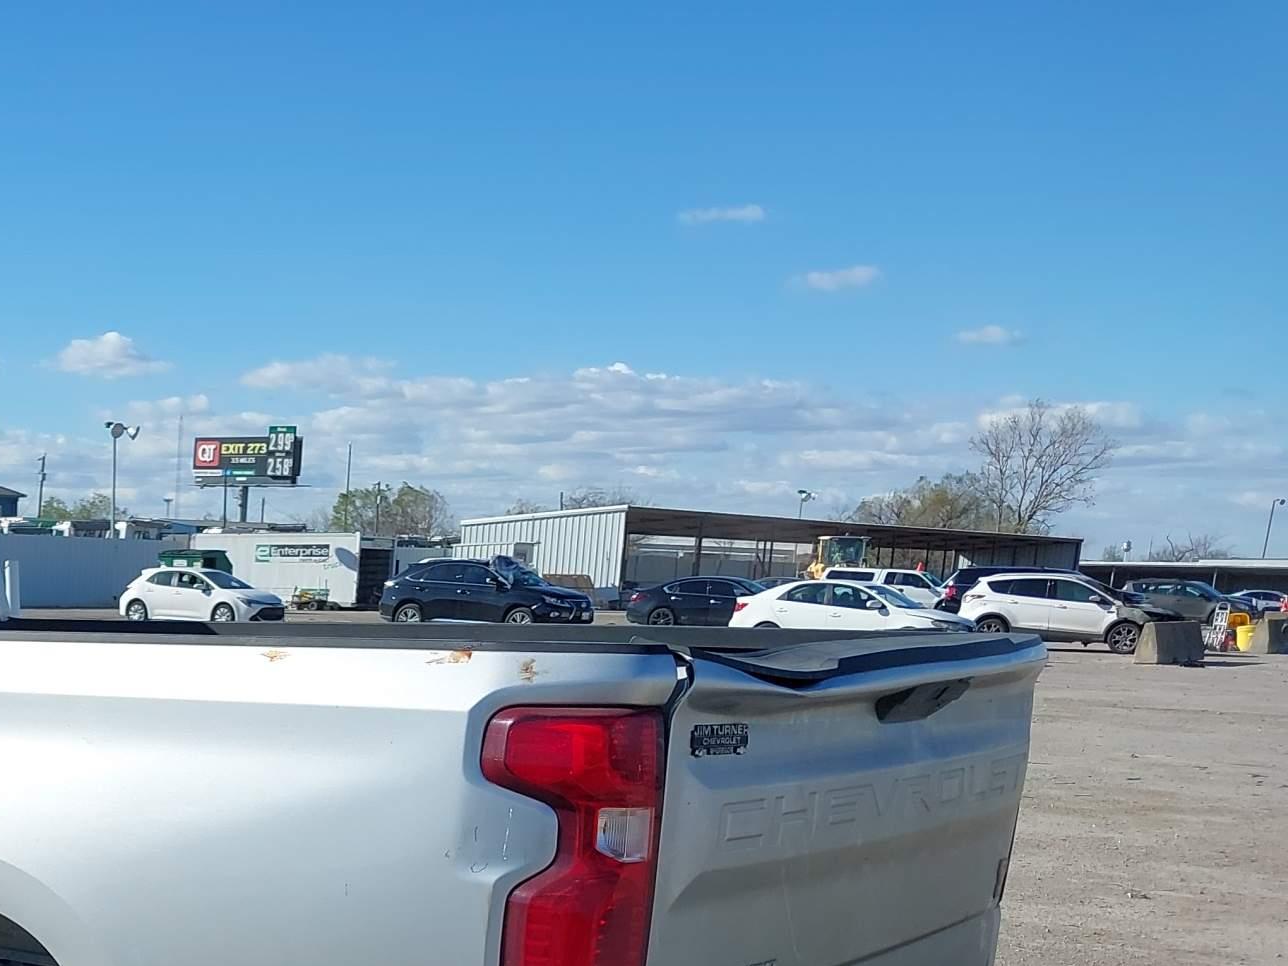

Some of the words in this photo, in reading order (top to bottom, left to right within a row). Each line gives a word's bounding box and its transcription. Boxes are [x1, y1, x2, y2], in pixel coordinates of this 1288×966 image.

[197, 444, 217, 463] QT
[220, 443, 246, 455] EXIT
[246, 443, 268, 455] 273
[270, 545, 329, 558] Enterprise
[694, 725, 712, 737] JIM
[712, 724, 749, 736] TURNER
[717, 752, 1028, 850] CHEVROLET
